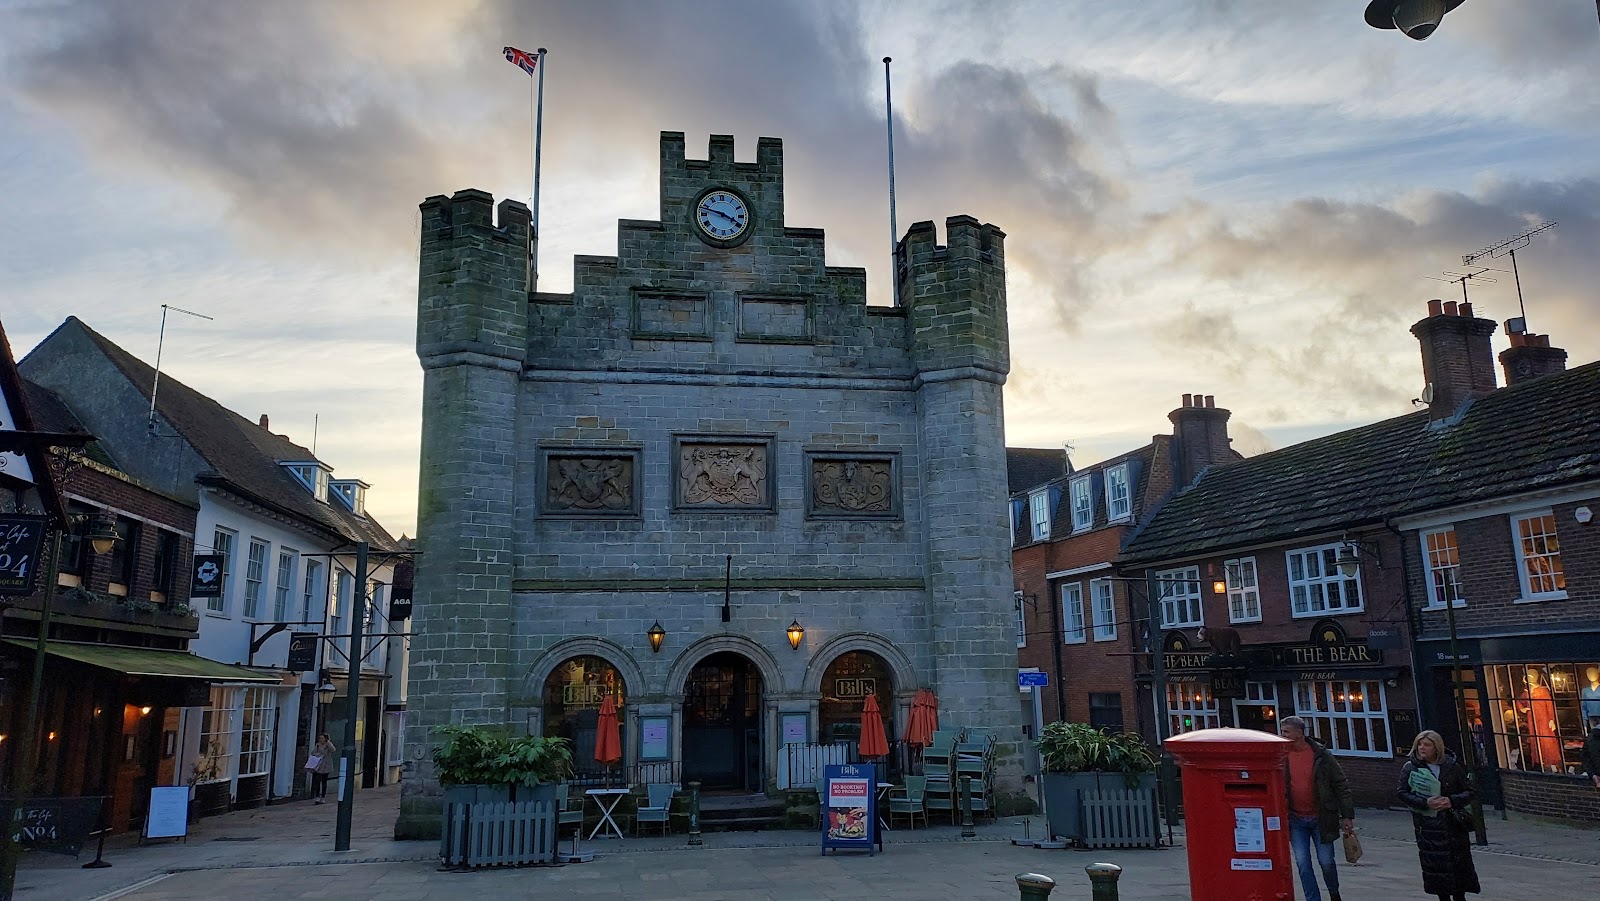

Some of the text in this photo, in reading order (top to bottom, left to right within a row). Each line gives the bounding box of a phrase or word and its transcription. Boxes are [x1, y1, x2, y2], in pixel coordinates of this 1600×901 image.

[1292, 645, 1371, 663] THE BEAR
[1300, 672, 1315, 680] THE
[840, 679, 873, 697] Bill's
